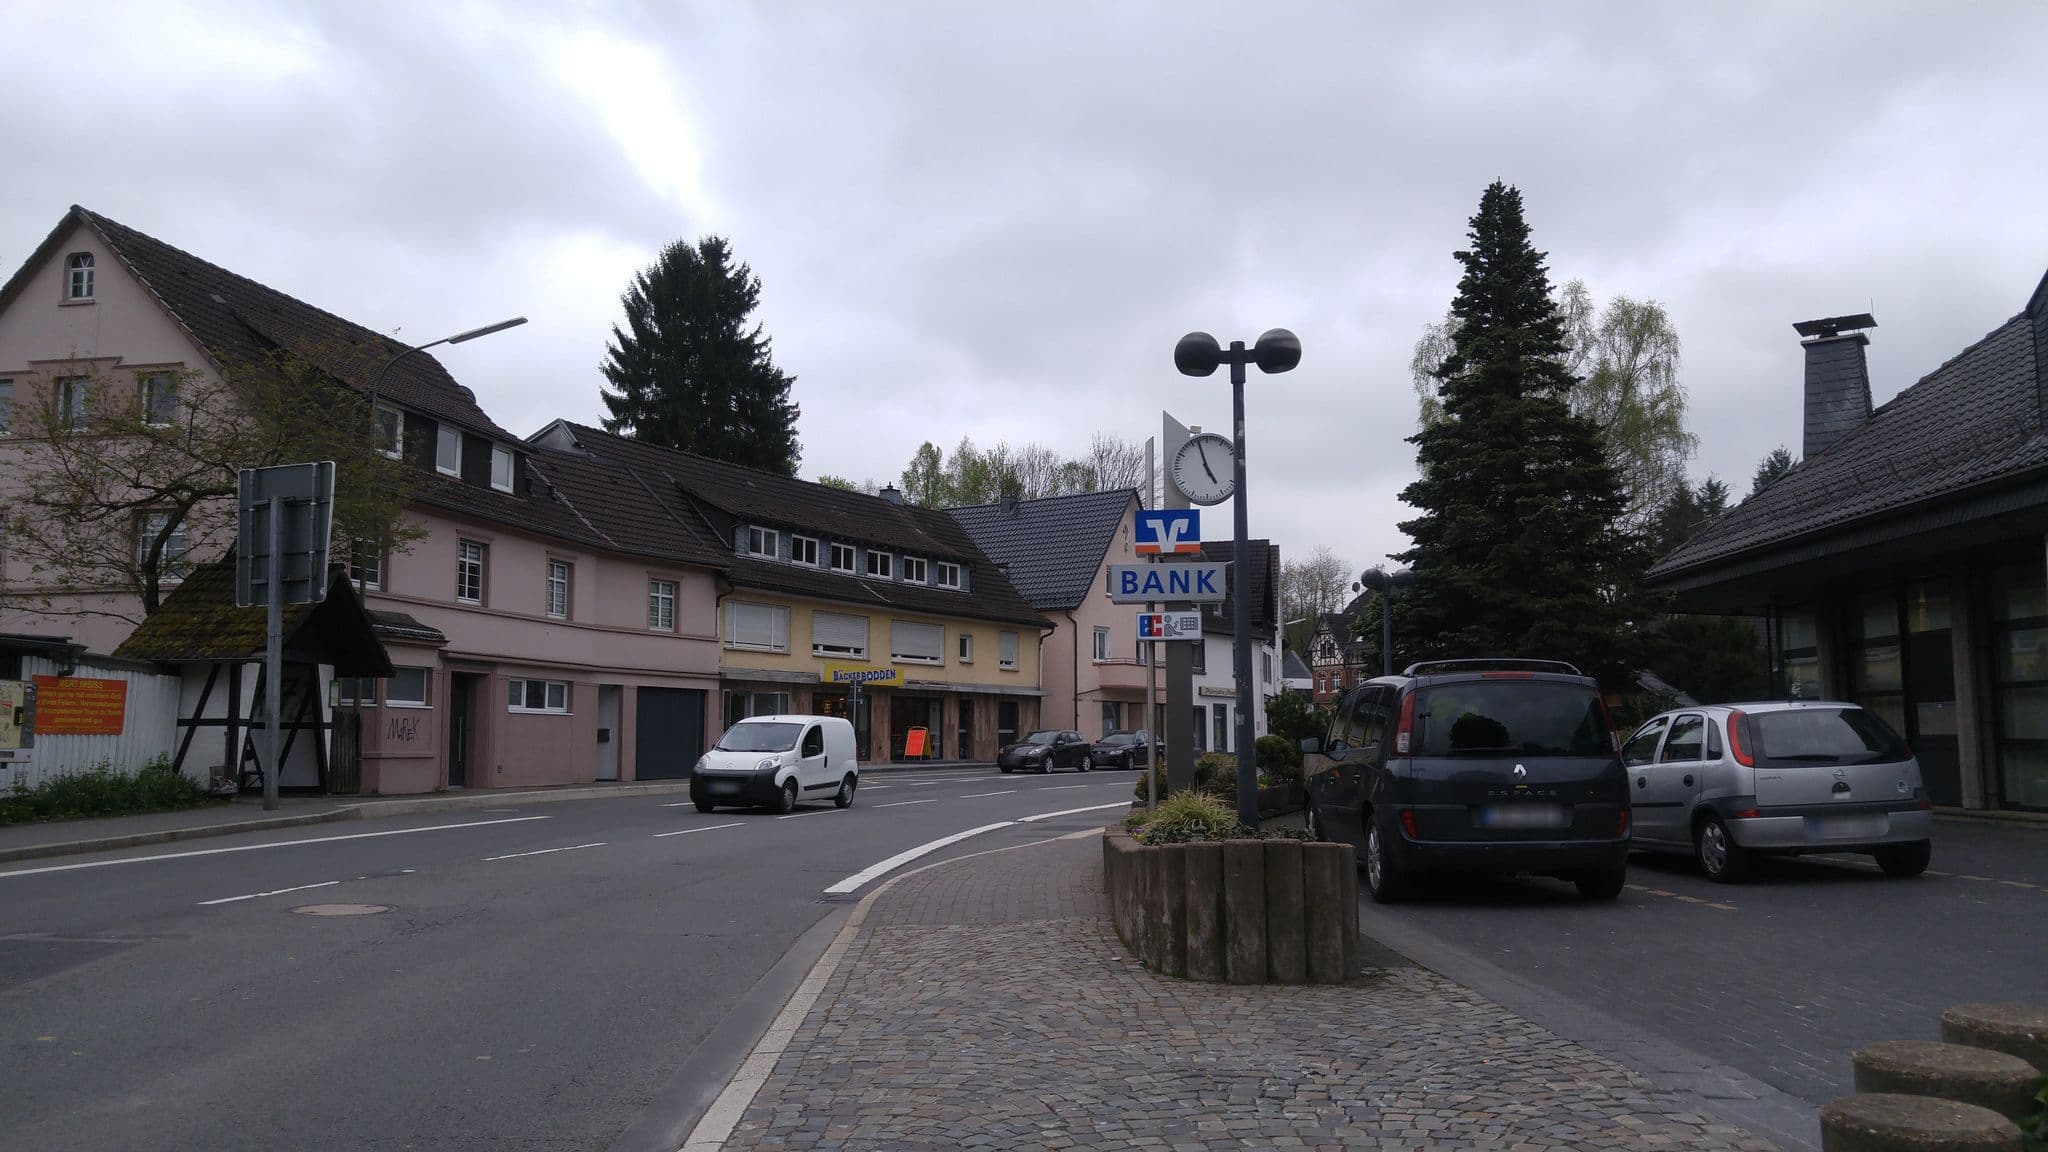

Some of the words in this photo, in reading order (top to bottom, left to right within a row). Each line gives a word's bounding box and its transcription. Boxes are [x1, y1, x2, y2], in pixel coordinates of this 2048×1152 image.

[1121, 569, 1217, 595] BANK
[833, 669, 860, 682] BÄCKER
[861, 669, 896, 681] BODDEN
